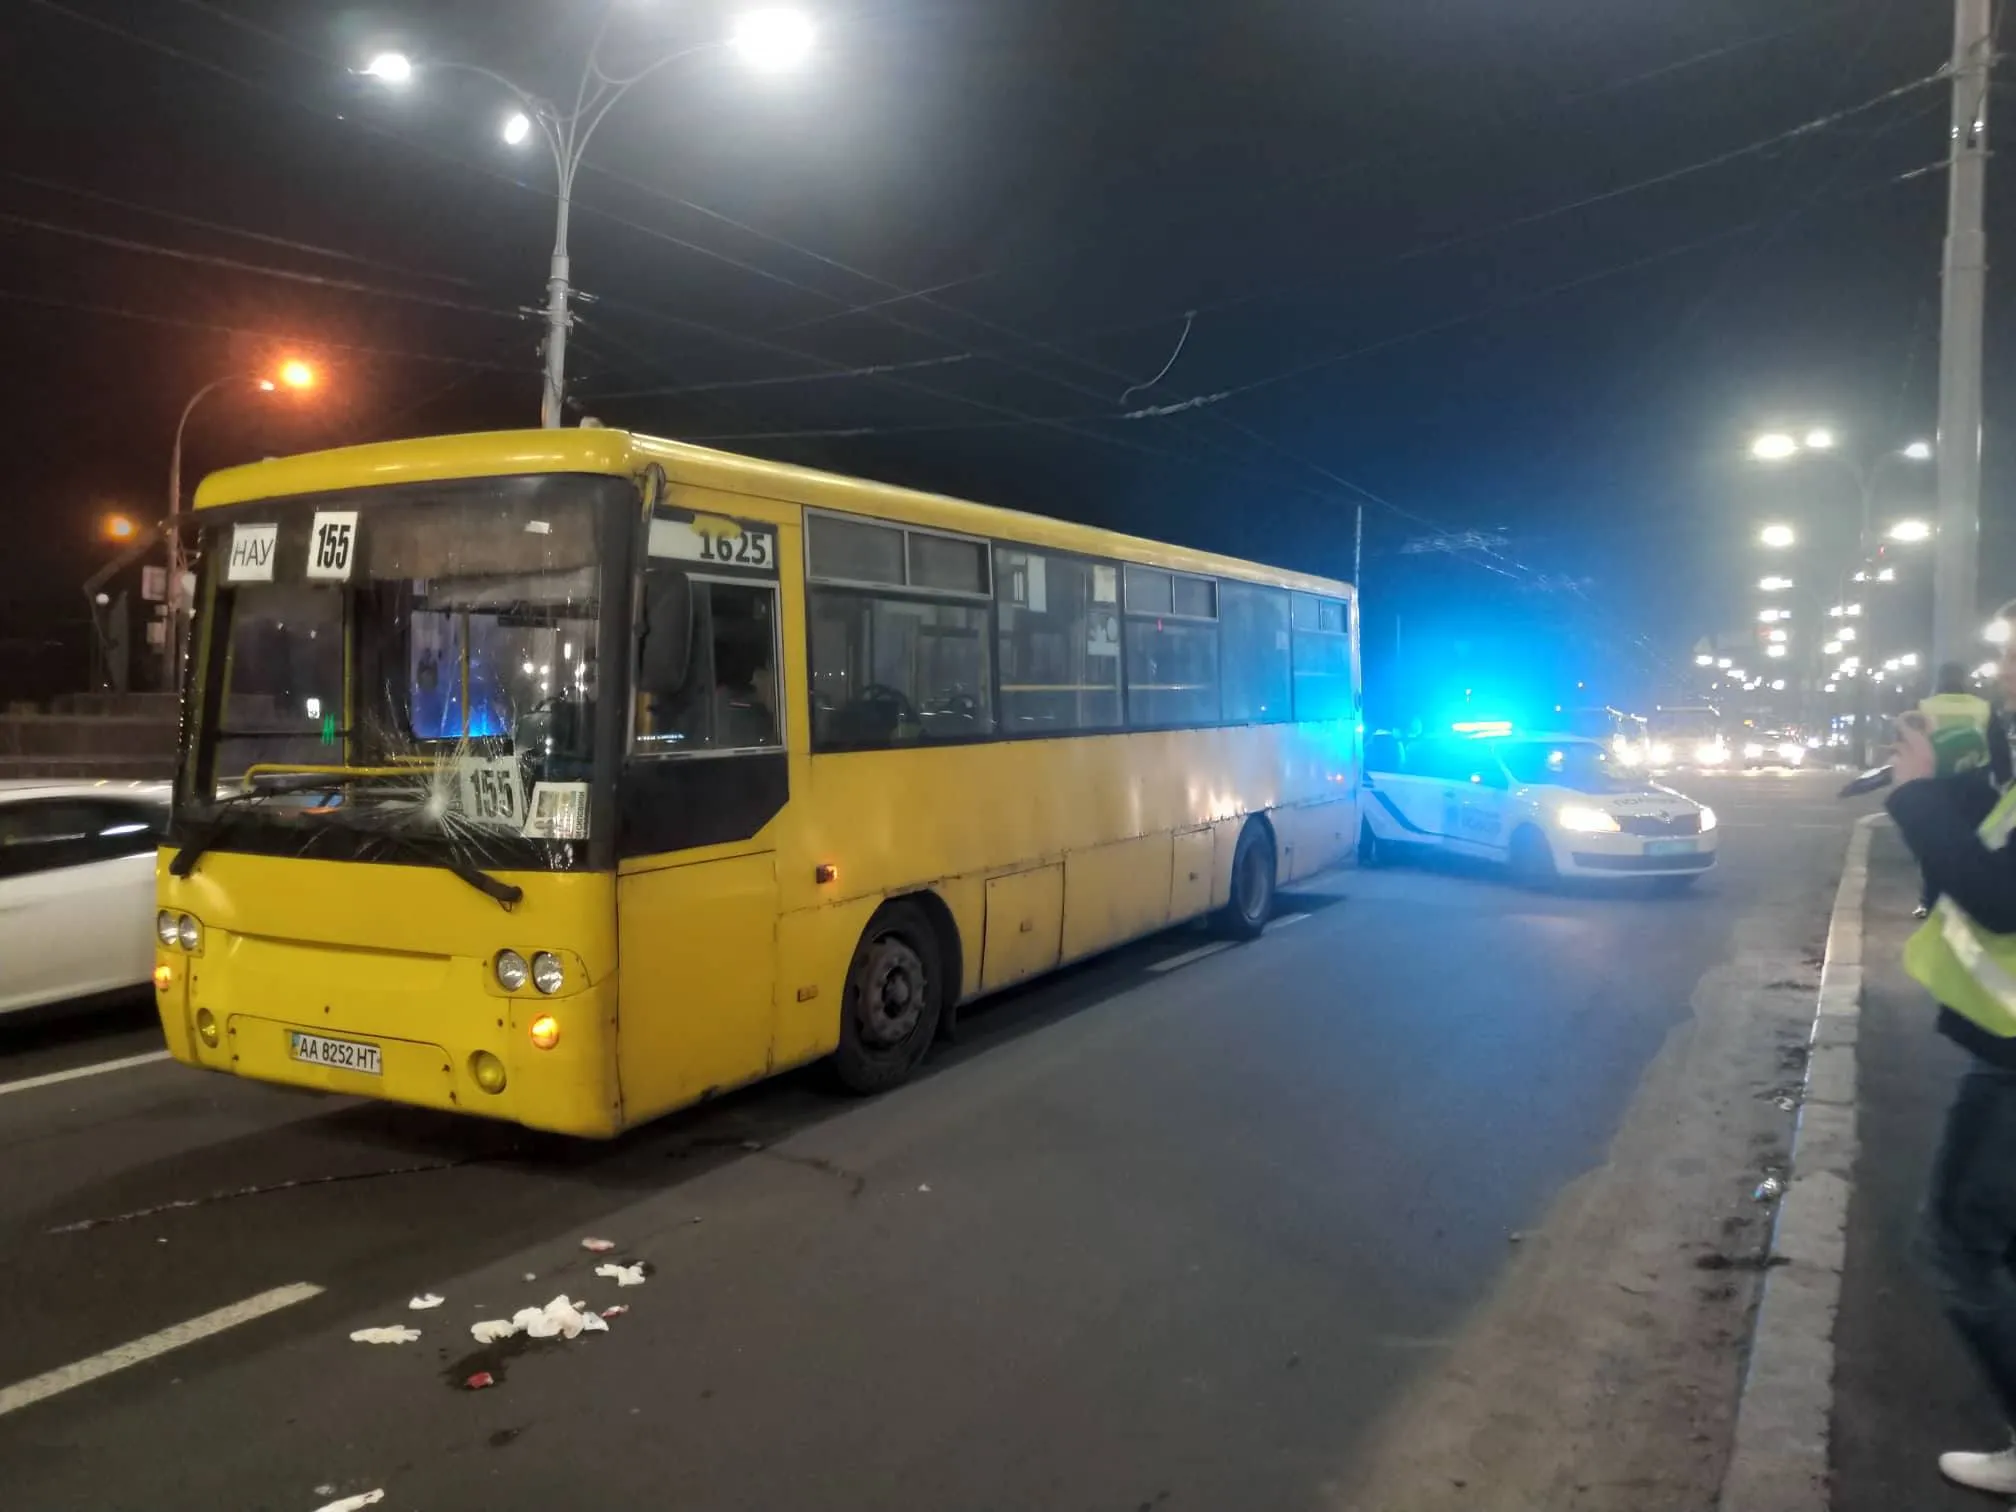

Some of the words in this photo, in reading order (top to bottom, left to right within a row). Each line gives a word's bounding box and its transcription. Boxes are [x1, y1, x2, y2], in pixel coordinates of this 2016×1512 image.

[232, 538, 274, 567] НАУ
[316, 523, 352, 570] 155
[700, 529, 766, 565] 1625
[470, 768, 514, 818] 155
[299, 1037, 319, 1059] AA
[322, 1042, 354, 1066] 8252
[356, 1047, 377, 1070] HT
